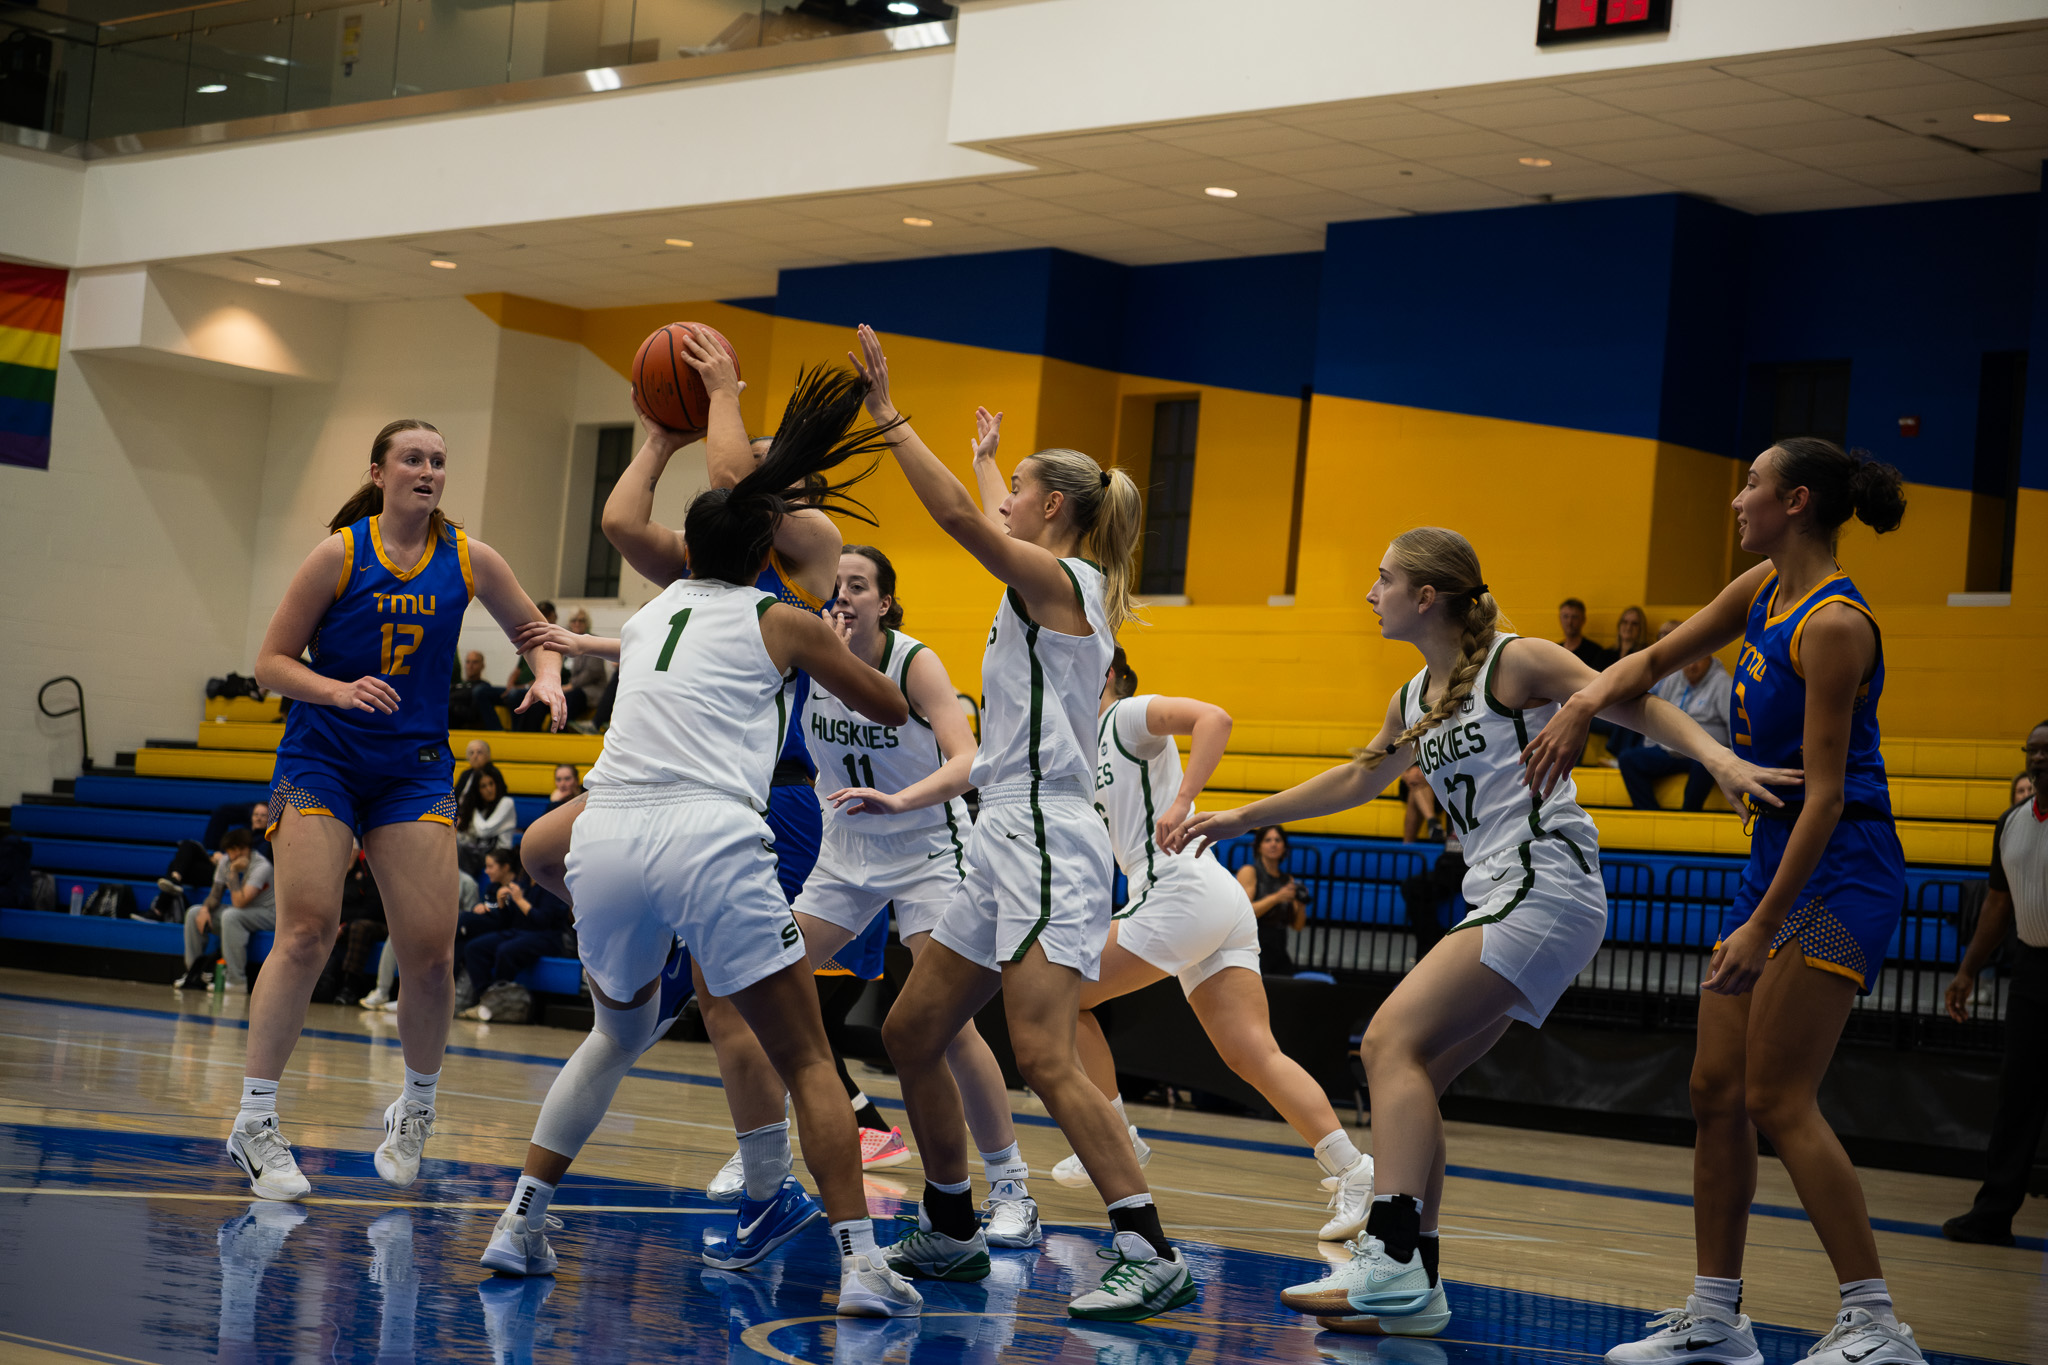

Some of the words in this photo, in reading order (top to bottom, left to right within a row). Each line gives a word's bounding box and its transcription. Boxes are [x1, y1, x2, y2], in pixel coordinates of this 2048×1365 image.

[373, 592, 435, 615] TMU
[380, 622, 424, 676] 12
[654, 607, 693, 672] 1
[811, 712, 899, 749] HUSKIES
[842, 753, 875, 789] 11
